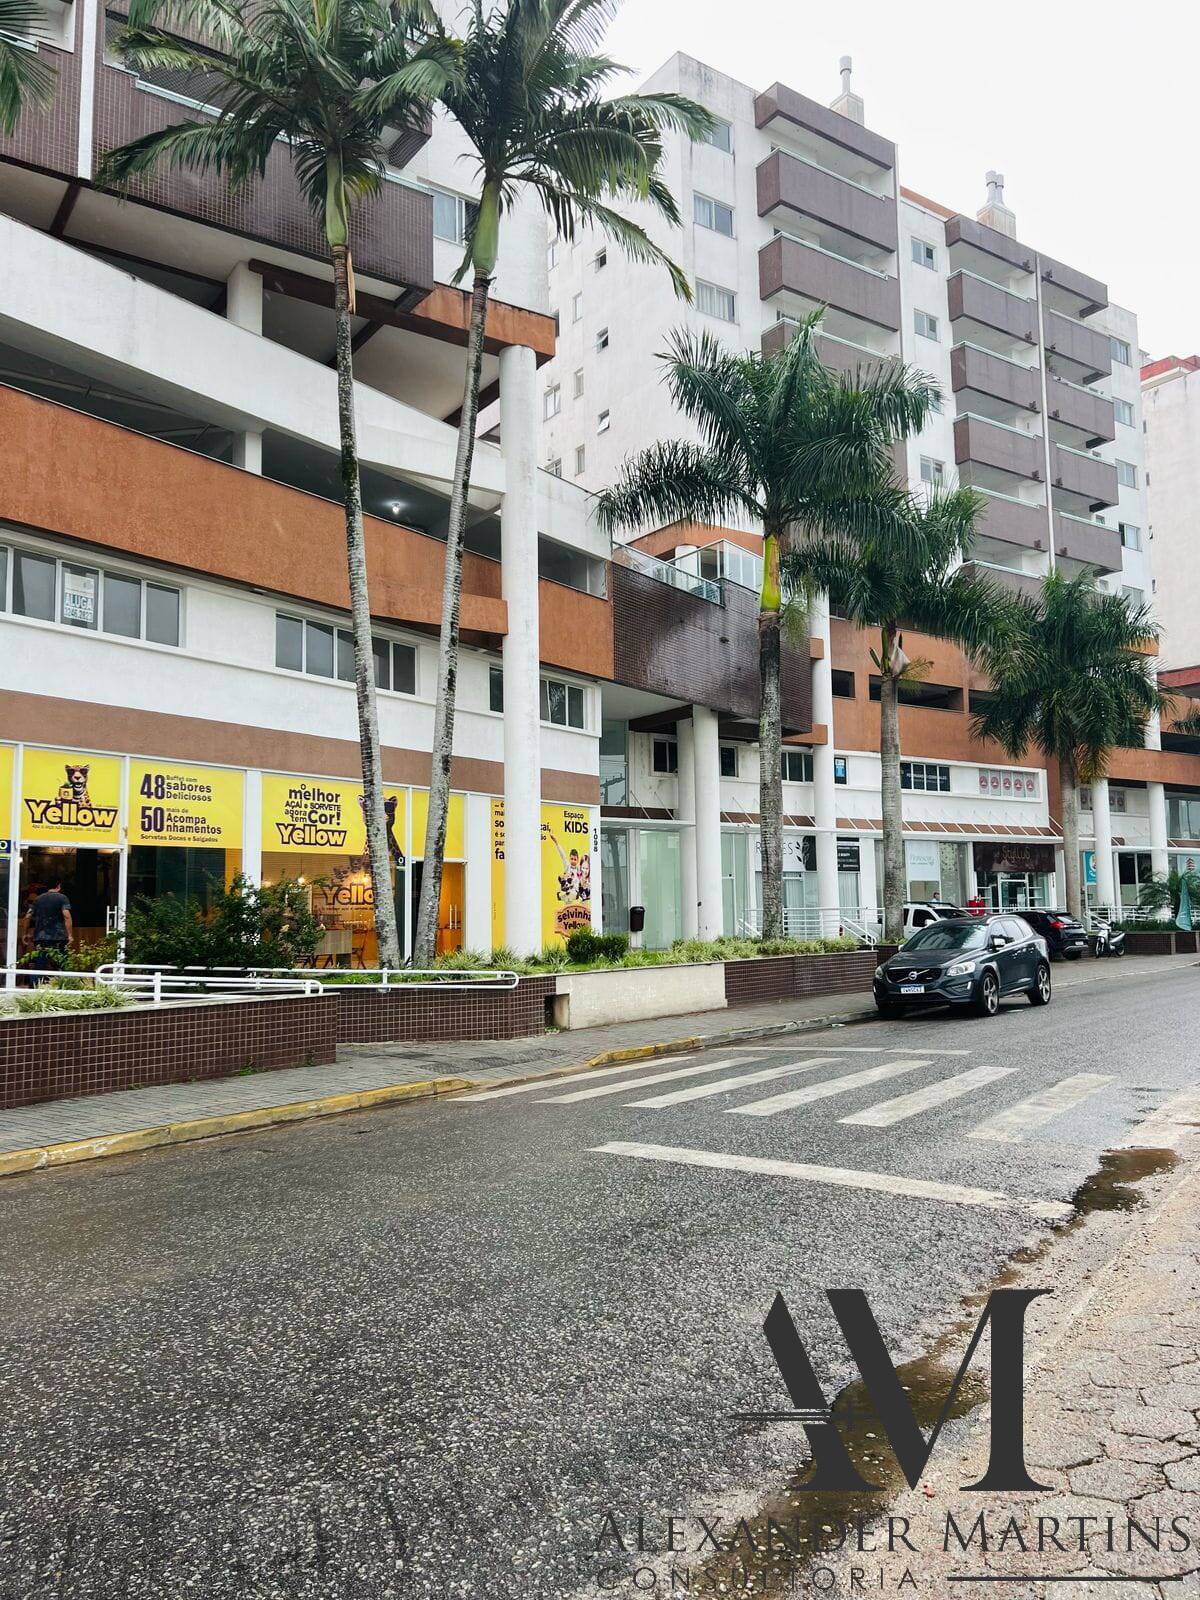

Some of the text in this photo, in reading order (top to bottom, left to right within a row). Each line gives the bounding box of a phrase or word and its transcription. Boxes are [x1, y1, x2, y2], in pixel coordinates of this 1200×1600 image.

[140, 773, 165, 800] 48
[166, 781, 212, 793] sabores
[166, 791, 212, 802] Deliciosos
[288, 788, 341, 803] melhor
[284, 808, 308, 816] agora
[310, 802, 342, 812] SORVETE
[24, 799, 118, 828] Yellow
[141, 806, 165, 832] 50
[166, 813, 206, 825] Acompa
[291, 814, 308, 822] tem
[307, 810, 341, 826] Cor!
[564, 811, 584, 819] Espaço
[166, 823, 222, 834] nhamentos
[564, 820, 589, 834] KIDS
[140, 833, 167, 841] Sorvetes
[275, 823, 347, 847] Yellow
[322, 883, 374, 906] Yello
